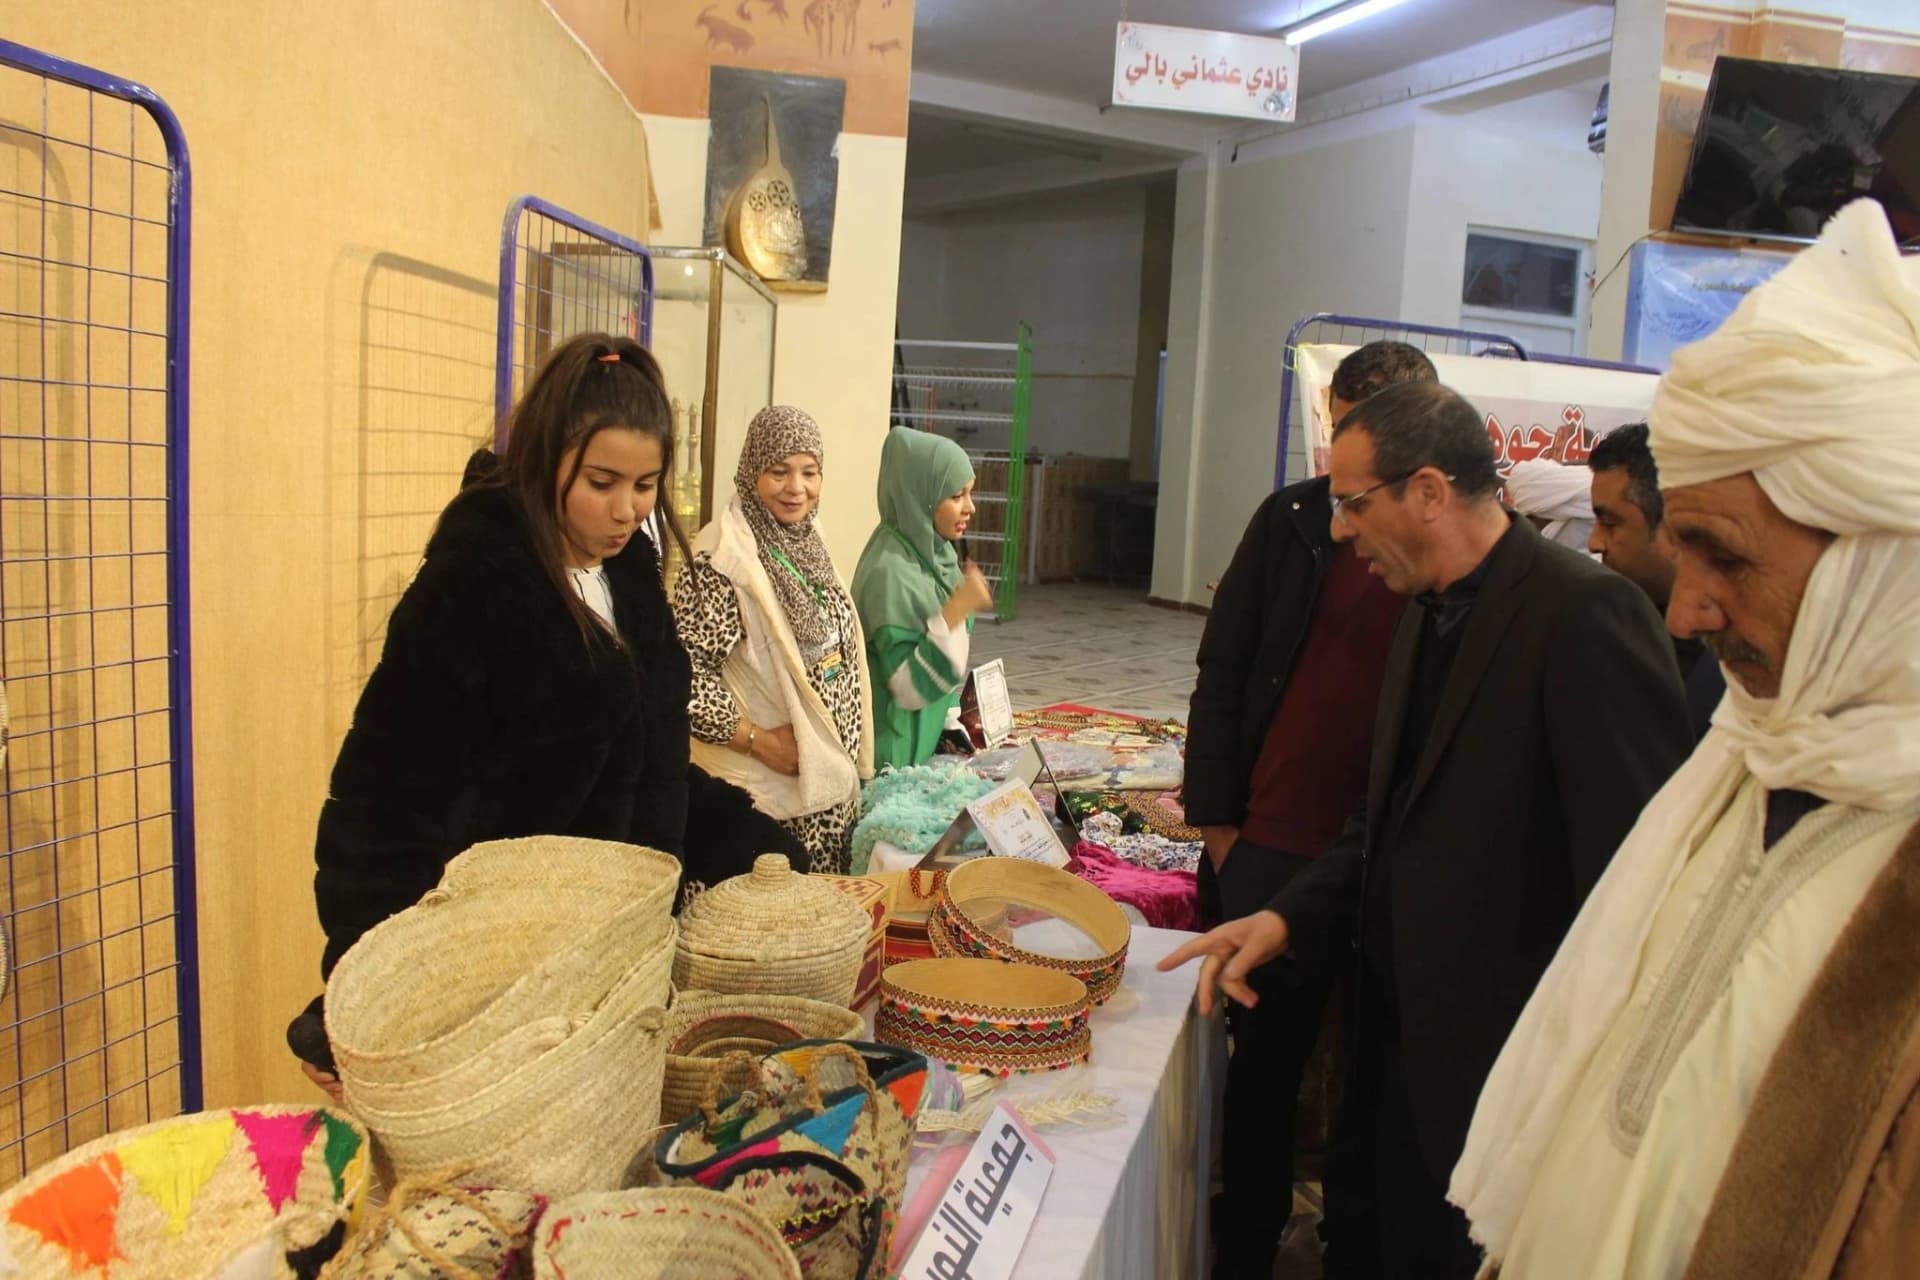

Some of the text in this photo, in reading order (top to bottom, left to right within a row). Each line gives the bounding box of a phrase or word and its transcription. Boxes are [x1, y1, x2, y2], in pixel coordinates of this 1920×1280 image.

[1125, 52, 1288, 96] نادي عثماني بالي
[953, 1123, 1033, 1227] جمعية
